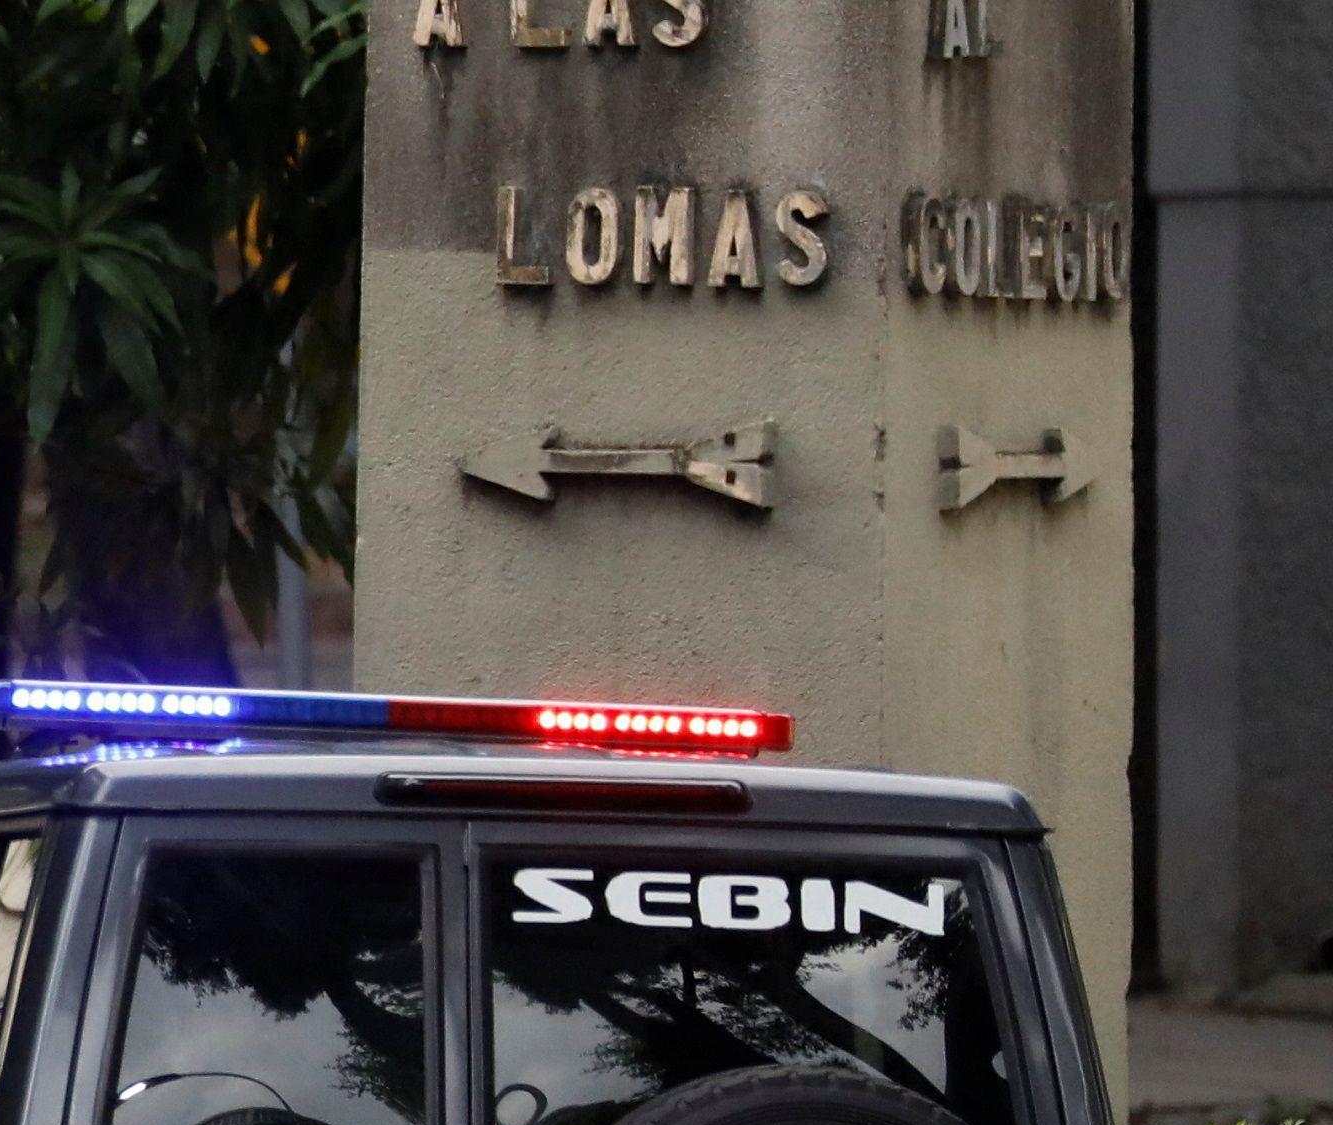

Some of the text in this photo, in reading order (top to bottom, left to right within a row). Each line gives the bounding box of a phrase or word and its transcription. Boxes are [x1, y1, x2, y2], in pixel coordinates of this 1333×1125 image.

[496, 185, 829, 287] LOMAS
[901, 195, 1131, 301] COLEGIO
[512, 868, 944, 936] SEBIN
